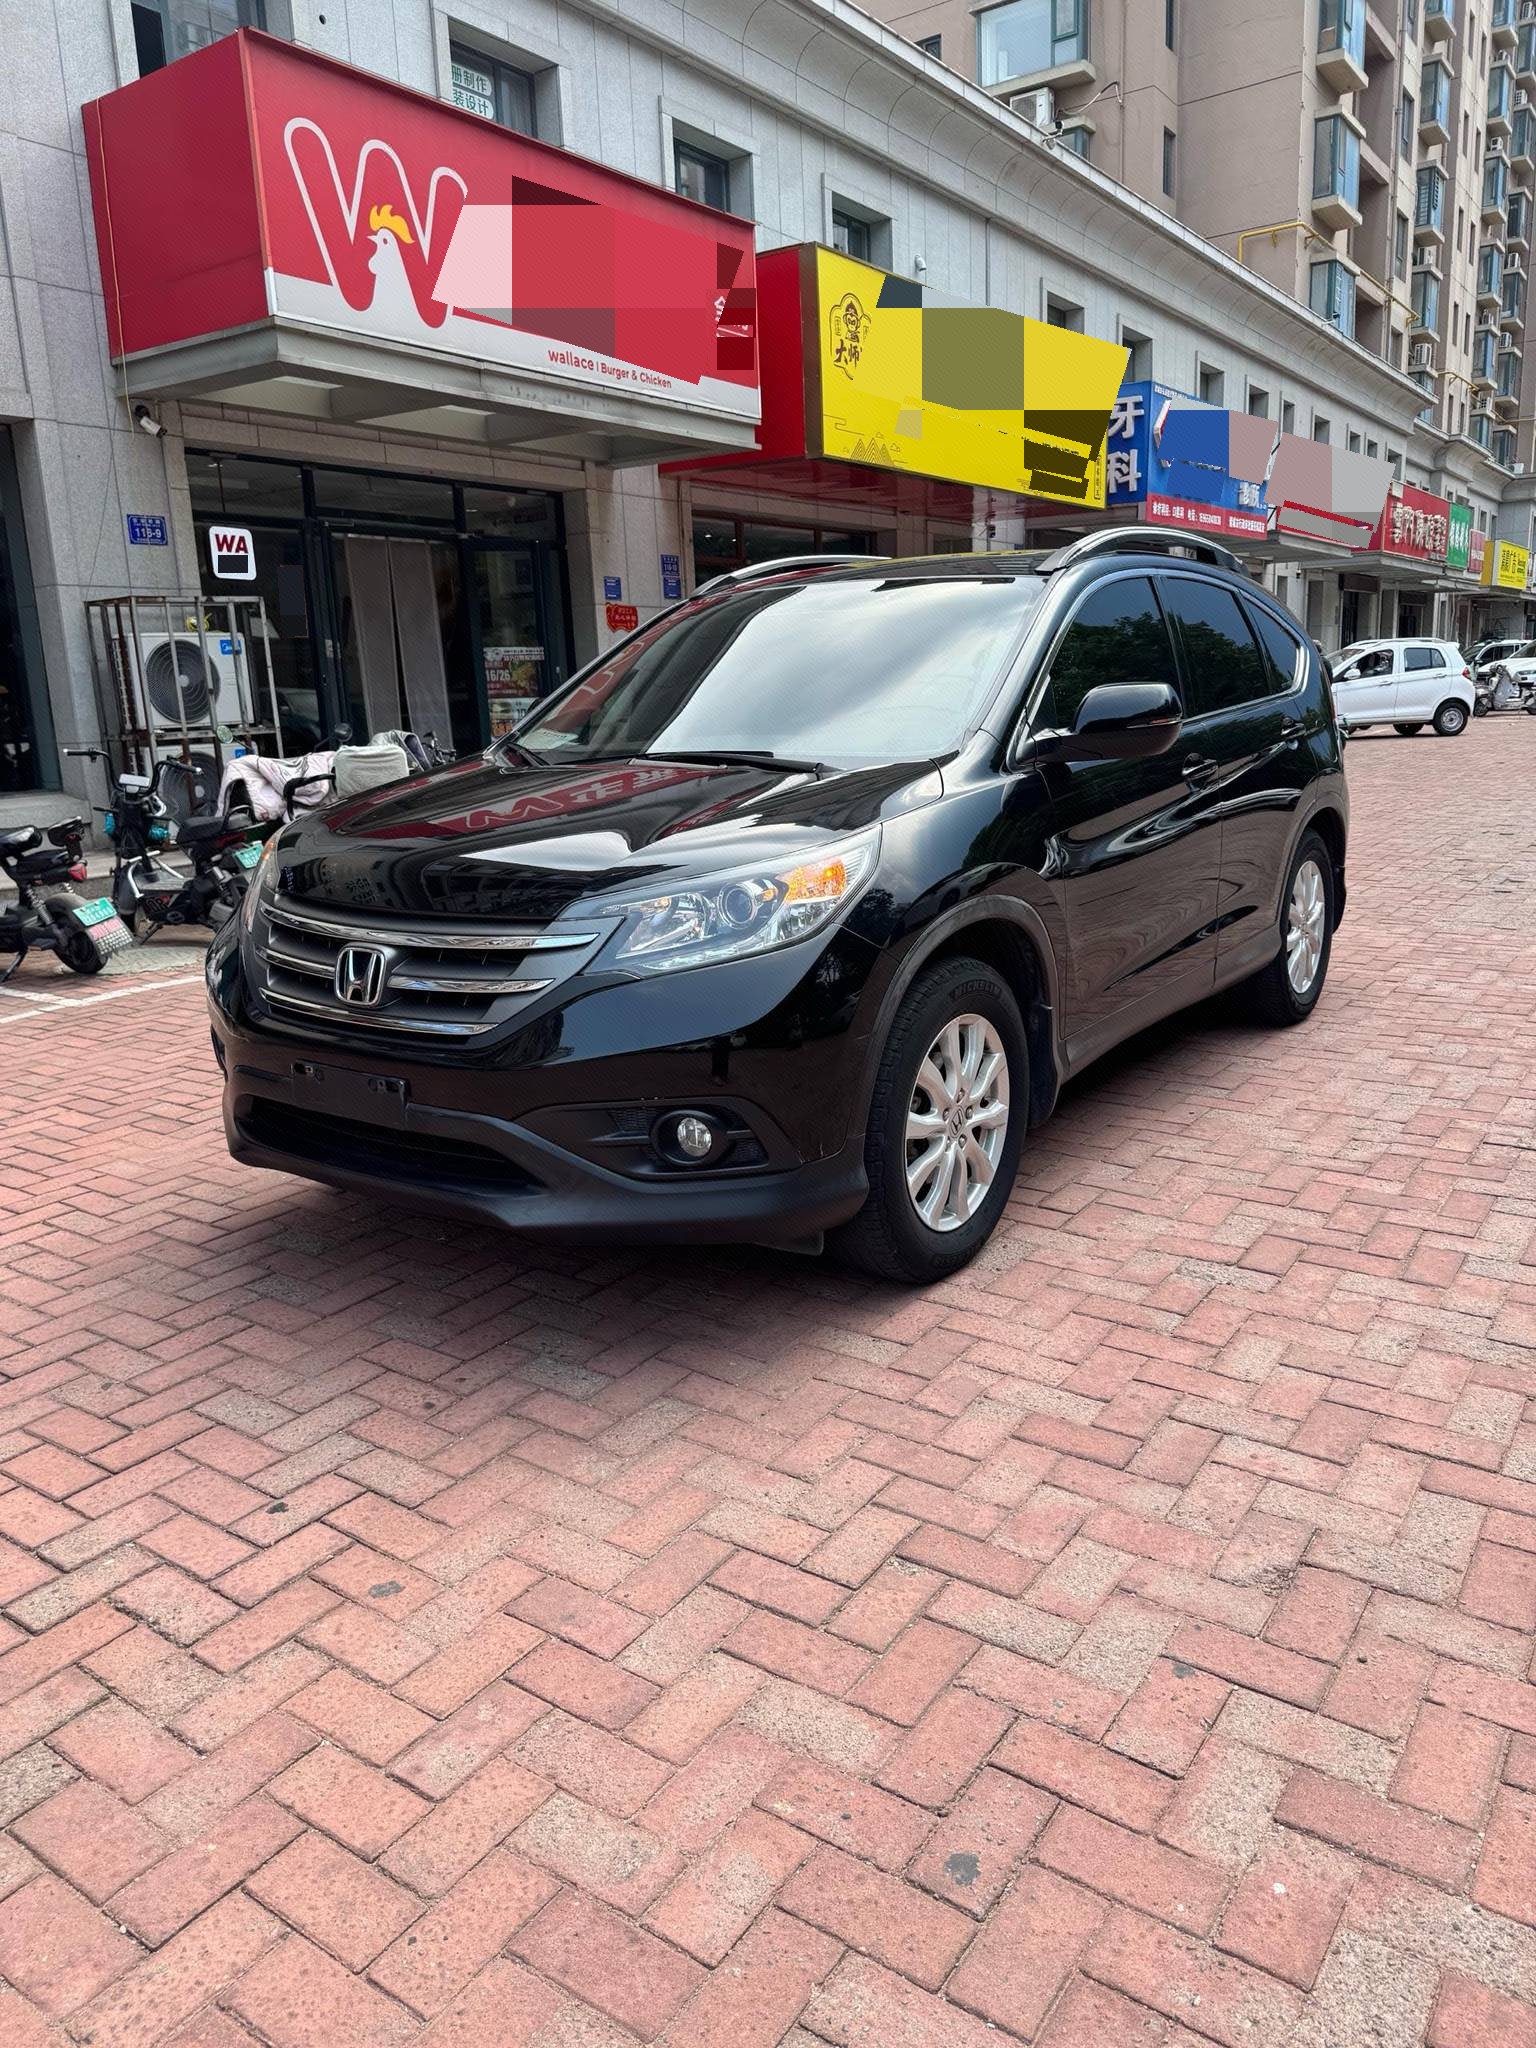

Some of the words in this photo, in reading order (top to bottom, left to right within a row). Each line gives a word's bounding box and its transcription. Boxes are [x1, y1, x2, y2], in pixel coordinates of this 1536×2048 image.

[834, 338, 863, 368] 大师
[601, 362, 629, 379] Burger
[631, 370, 638, 381] &
[639, 372, 672, 389] Chicken
[1107, 395, 1144, 494] 牙科
[215, 533, 249, 554] WA
